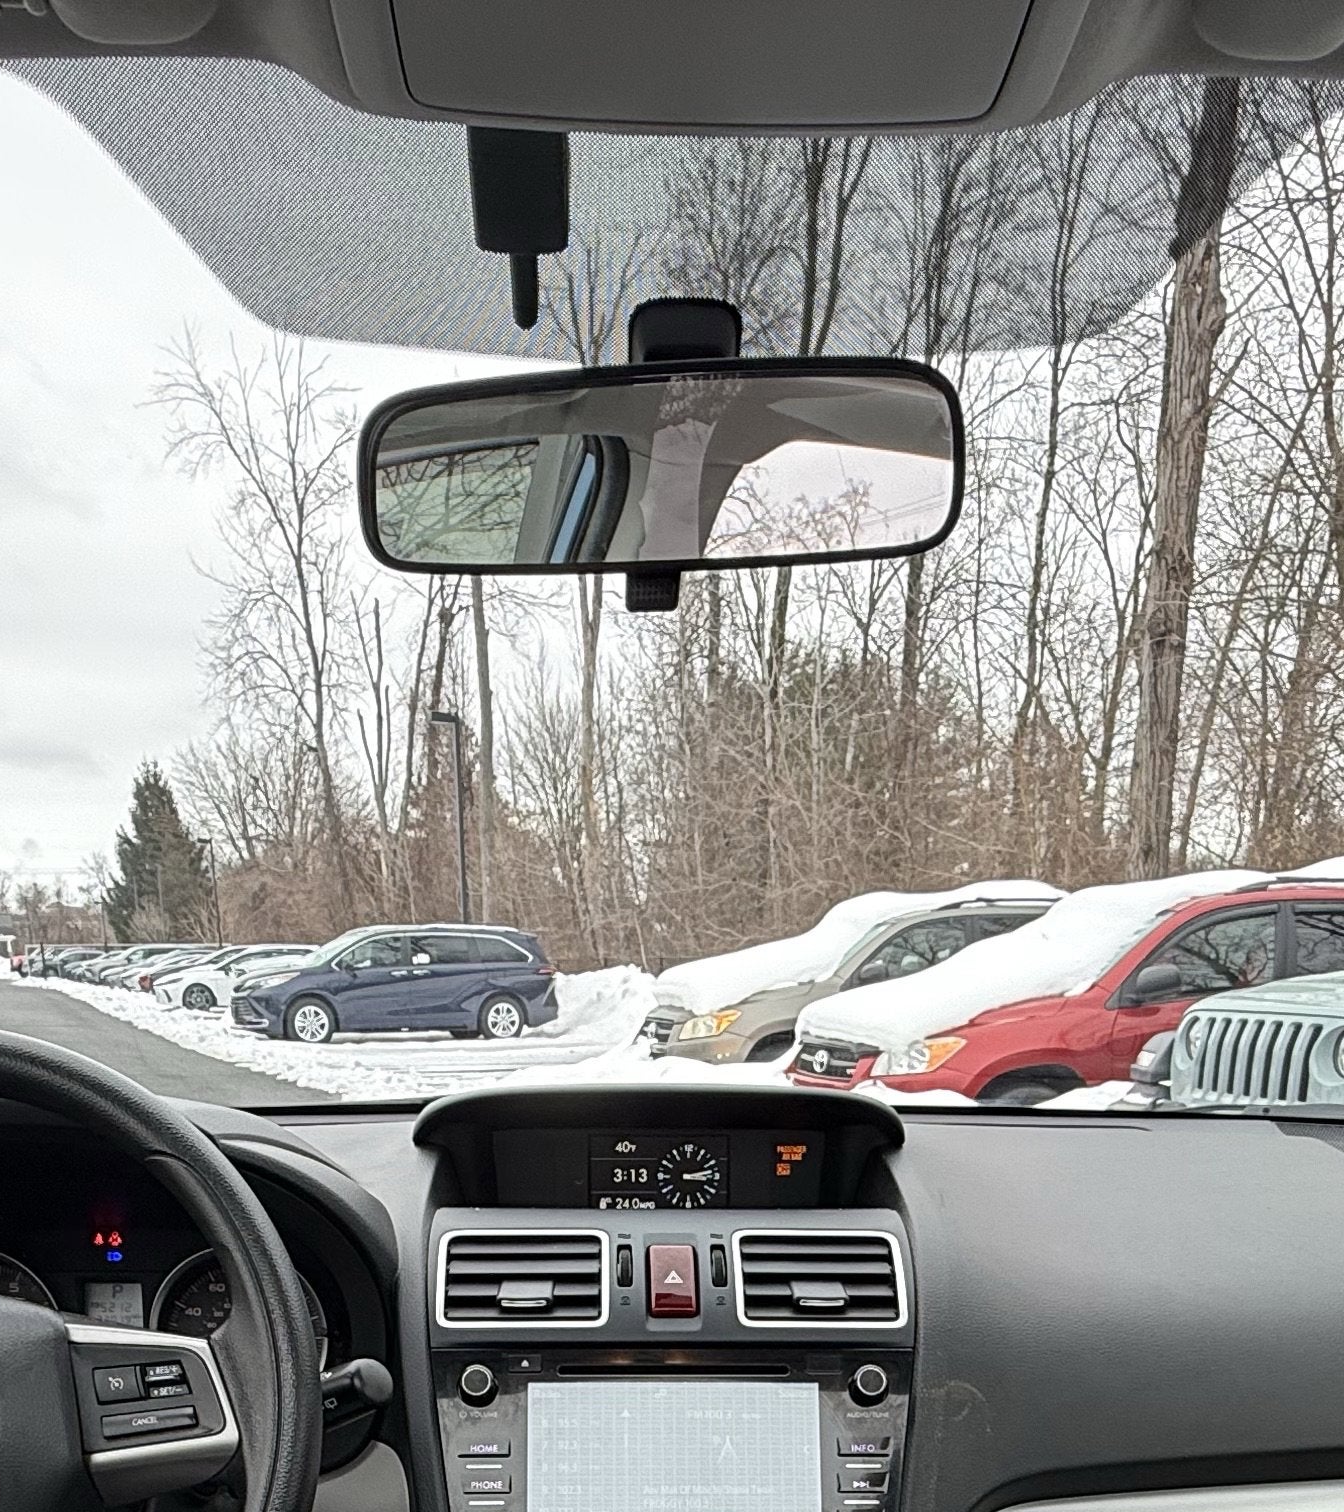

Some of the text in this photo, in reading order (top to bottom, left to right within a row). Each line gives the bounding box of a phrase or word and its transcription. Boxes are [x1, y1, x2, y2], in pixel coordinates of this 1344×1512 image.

[613, 1168, 648, 1183] 3:13
[112, 1284, 124, 1299] P
[209, 1283, 226, 1293] 60
[185, 1307, 202, 1317] 40
[470, 1444, 499, 1453] HOME
[851, 1444, 875, 1453] INFO
[470, 1480, 504, 1490] PHONE
